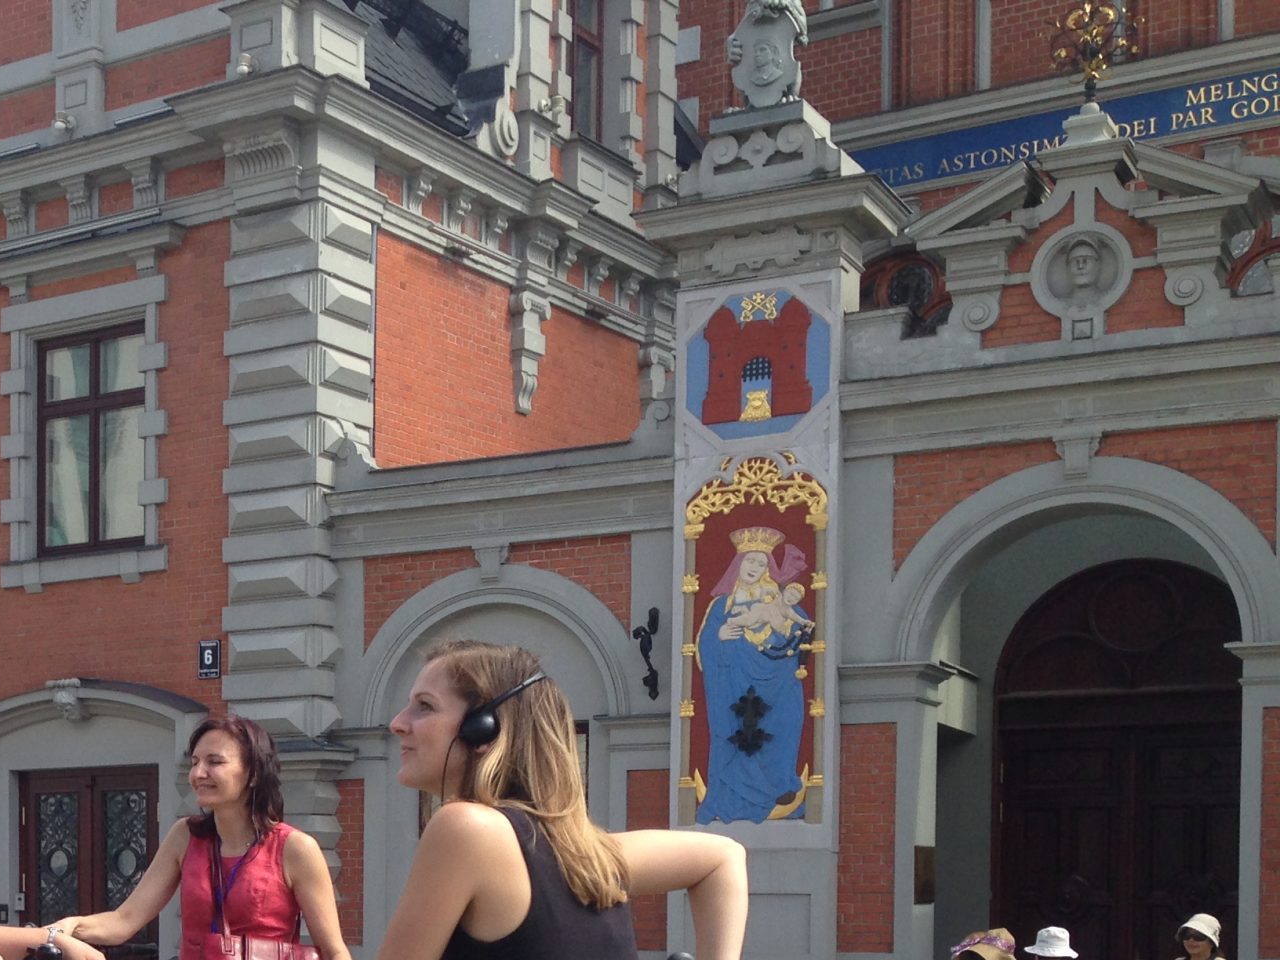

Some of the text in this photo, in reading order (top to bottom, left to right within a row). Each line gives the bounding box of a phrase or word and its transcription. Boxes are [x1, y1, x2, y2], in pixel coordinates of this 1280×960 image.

[1185, 73, 1279, 107] MELNG
[870, 161, 924, 184] TAS
[1171, 107, 1216, 131] PAR
[204, 649, 213, 665] 6
